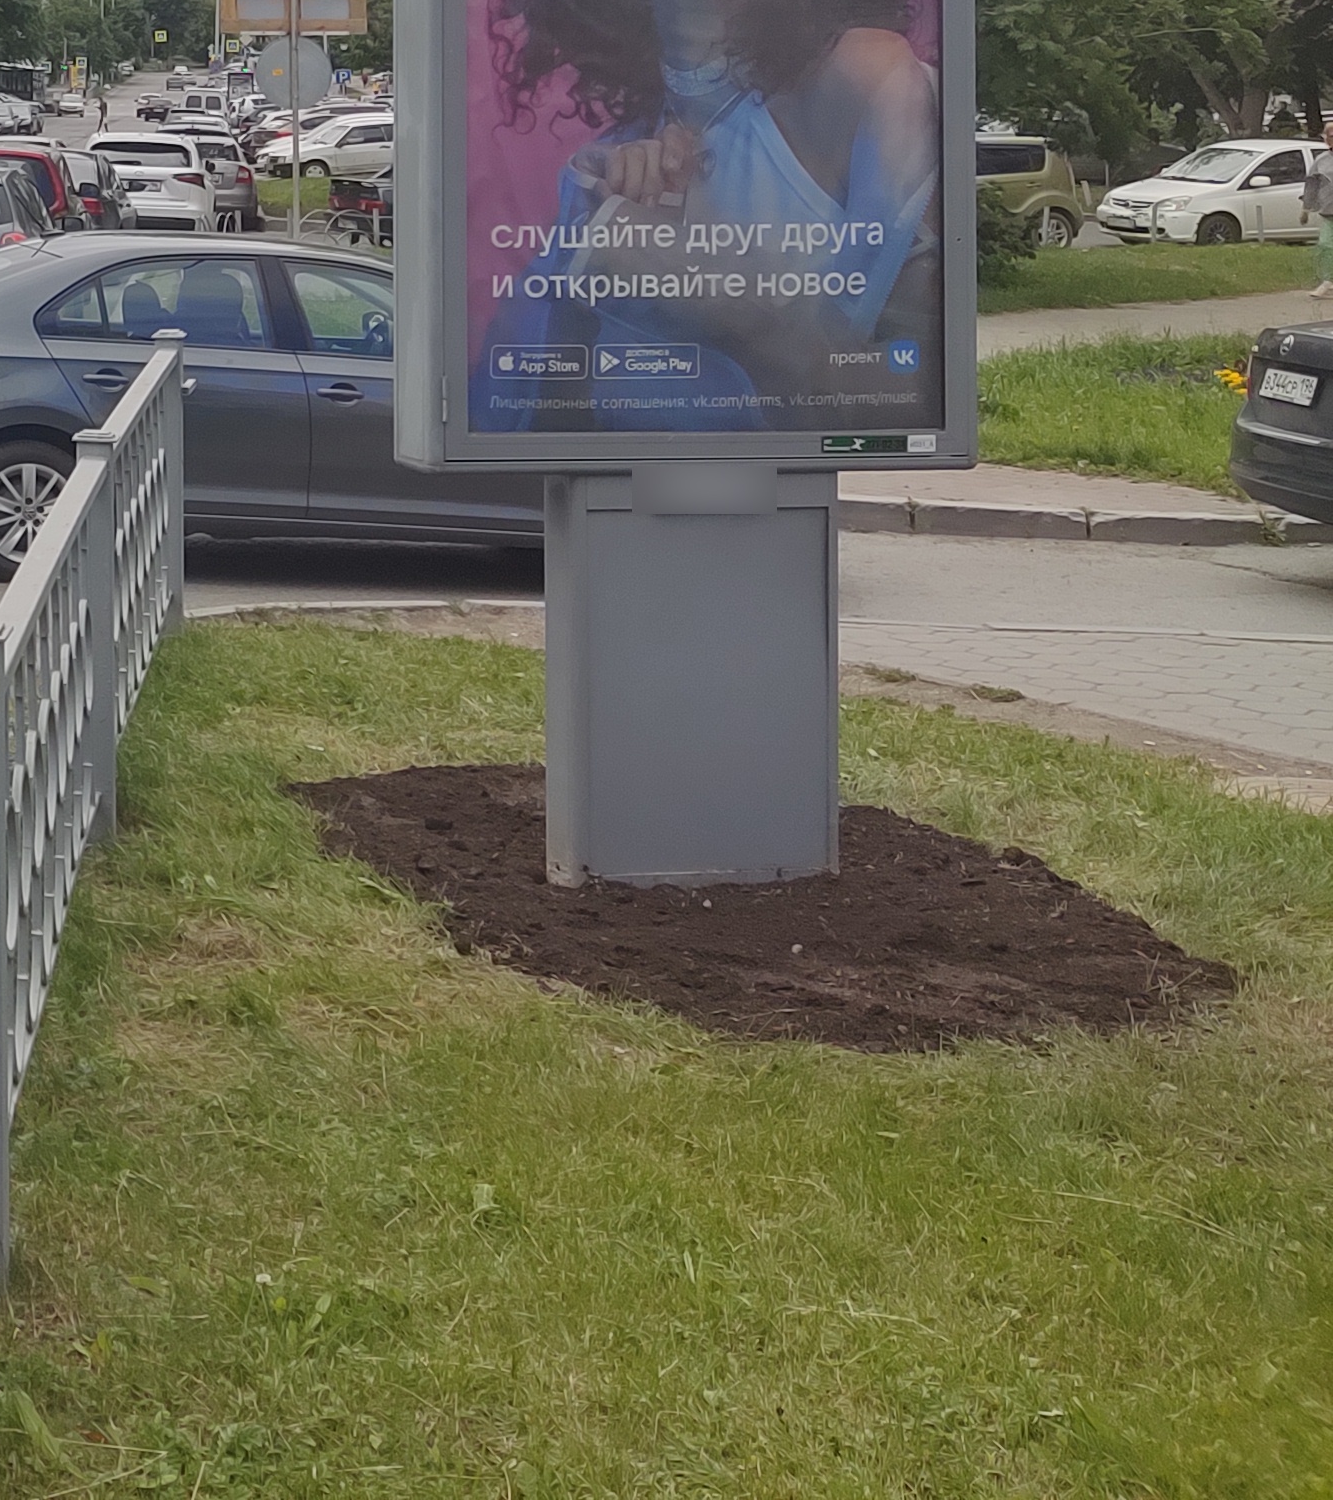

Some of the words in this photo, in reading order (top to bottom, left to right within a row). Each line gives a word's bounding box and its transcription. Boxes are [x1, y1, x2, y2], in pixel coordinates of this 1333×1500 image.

[339, 71, 349, 83] P
[490, 215, 677, 258] слушайте
[685, 223, 773, 256] друг
[781, 221, 884, 255] друга
[492, 275, 514, 299] и
[523, 265, 747, 308] открывайте
[757, 271, 867, 297] новое
[518, 359, 546, 374] App
[548, 359, 581, 373] Store
[624, 358, 667, 374] Google
[669, 358, 693, 373] Play
[829, 352, 883, 368] проект
[893, 349, 915, 366] VK
[489, 395, 598, 410] Лицензионные
[601, 395, 689, 409] соглашения:
[692, 393, 784, 410] vk.com/terms,
[788, 390, 918, 407] vk.com/terms/music
